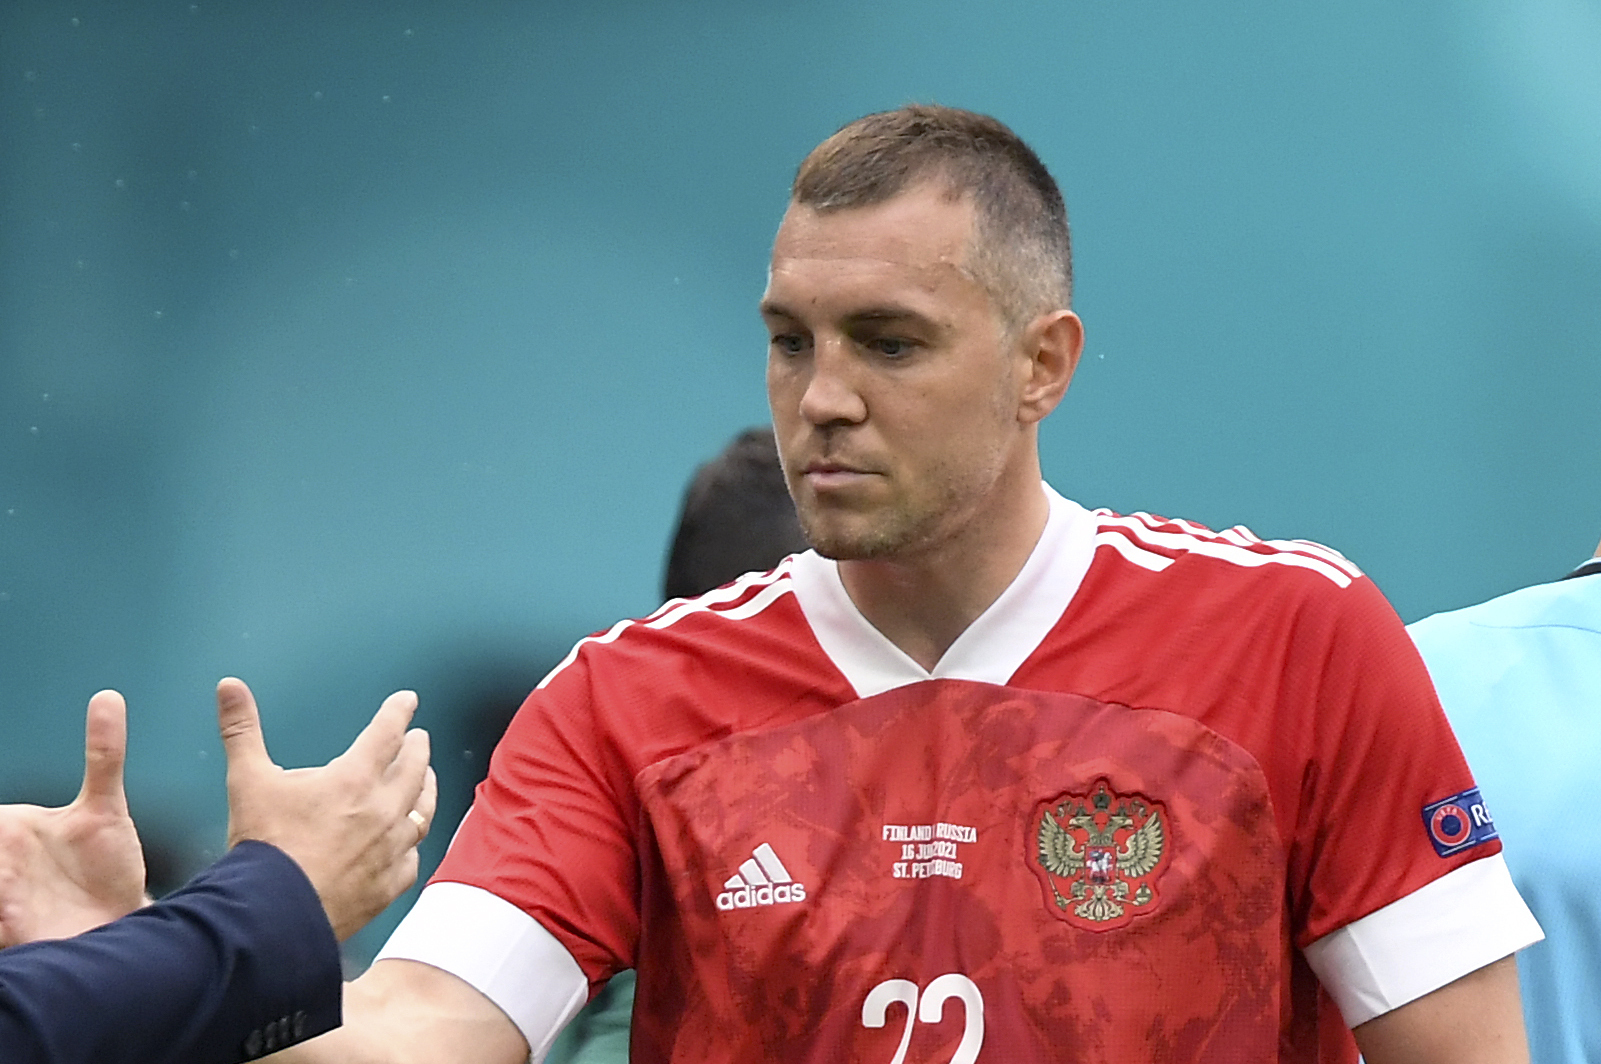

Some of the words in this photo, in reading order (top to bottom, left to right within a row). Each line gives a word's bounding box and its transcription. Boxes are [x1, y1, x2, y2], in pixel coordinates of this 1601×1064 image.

[882, 824, 932, 841] FINLAND
[936, 822, 977, 843] RUSSIA
[901, 843, 915, 860] 16
[931, 840, 957, 860] 2021
[893, 862, 911, 878] ST.
[716, 881, 806, 911] adidas
